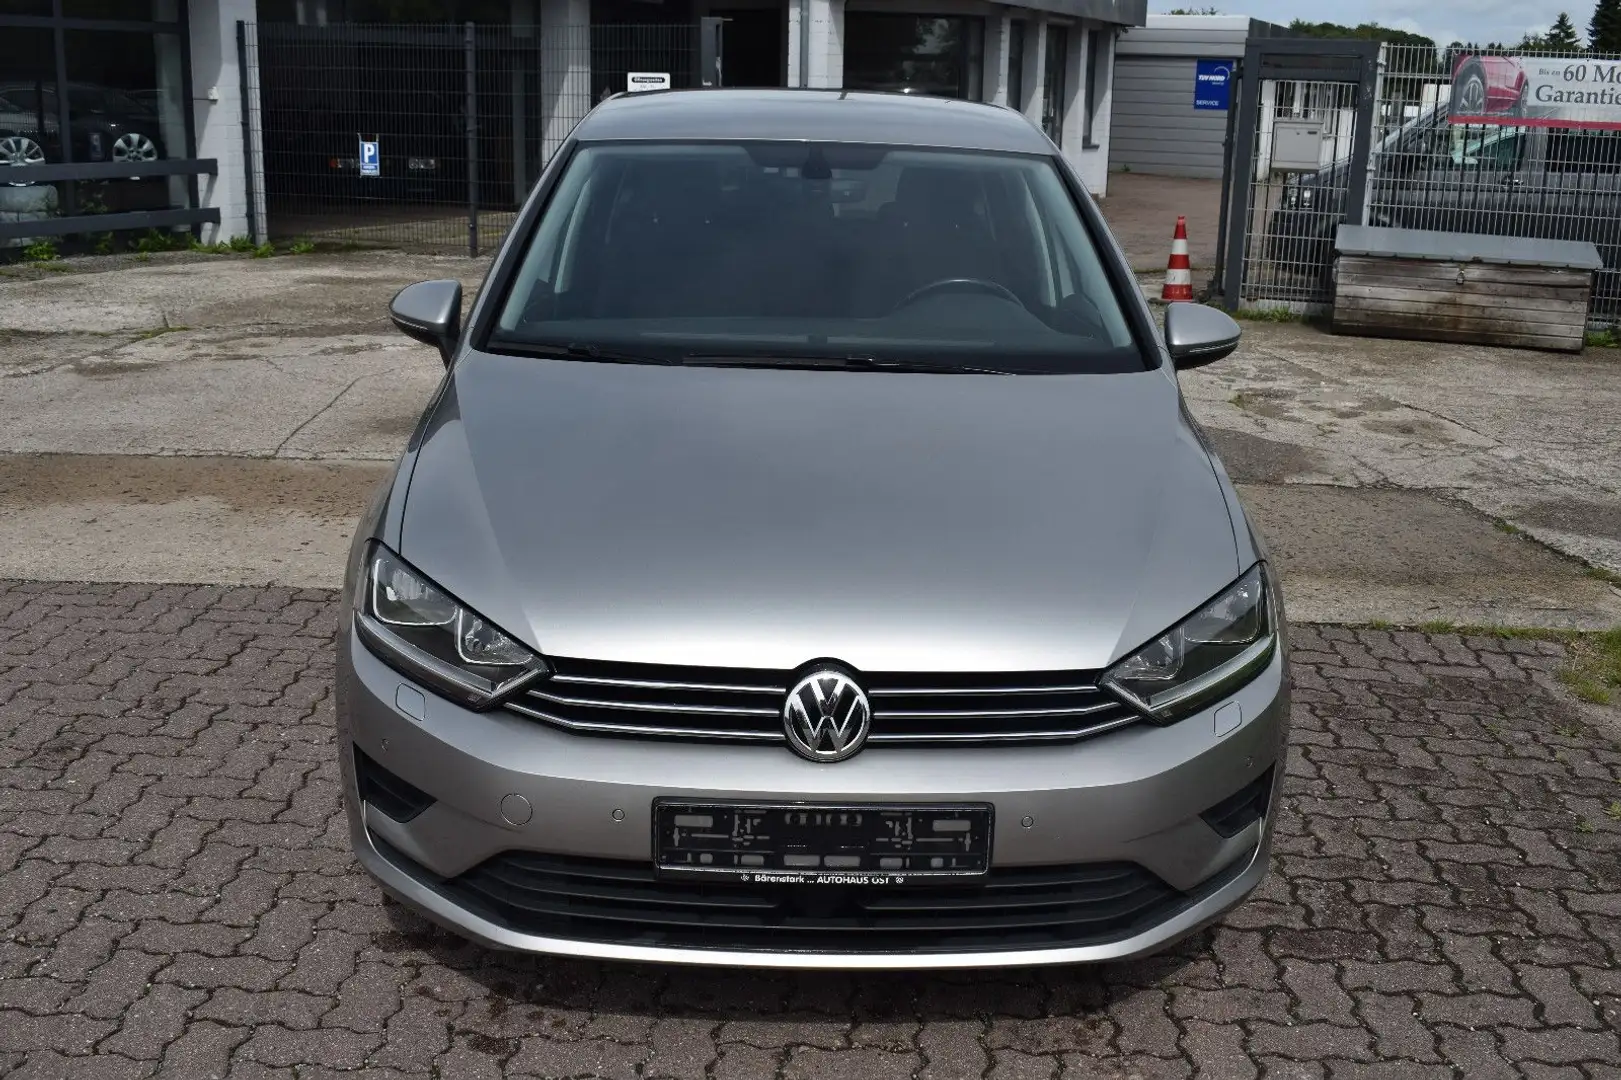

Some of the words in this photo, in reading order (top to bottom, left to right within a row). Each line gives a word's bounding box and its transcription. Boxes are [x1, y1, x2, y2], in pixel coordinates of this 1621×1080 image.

[1563, 64, 1587, 82] 60
[364, 143, 375, 164] P
[754, 874, 804, 883] Bärenstark
[817, 875, 869, 884] AUTOHAUS
